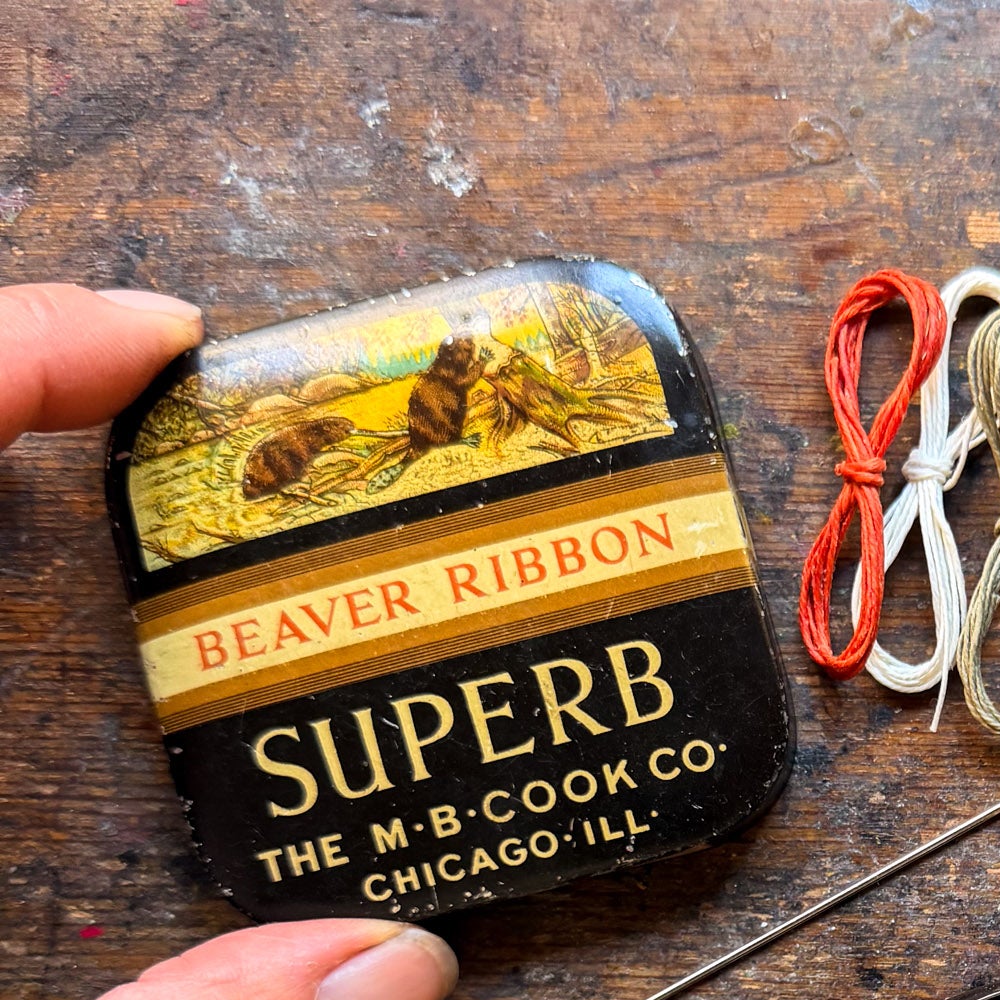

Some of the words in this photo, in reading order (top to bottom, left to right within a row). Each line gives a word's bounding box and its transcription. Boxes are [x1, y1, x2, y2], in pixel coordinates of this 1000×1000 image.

[193, 579, 421, 671] BEAVER
[445, 512, 676, 603] RIBBON
[253, 639, 676, 817] SUPERB
[258, 833, 350, 882] THE
